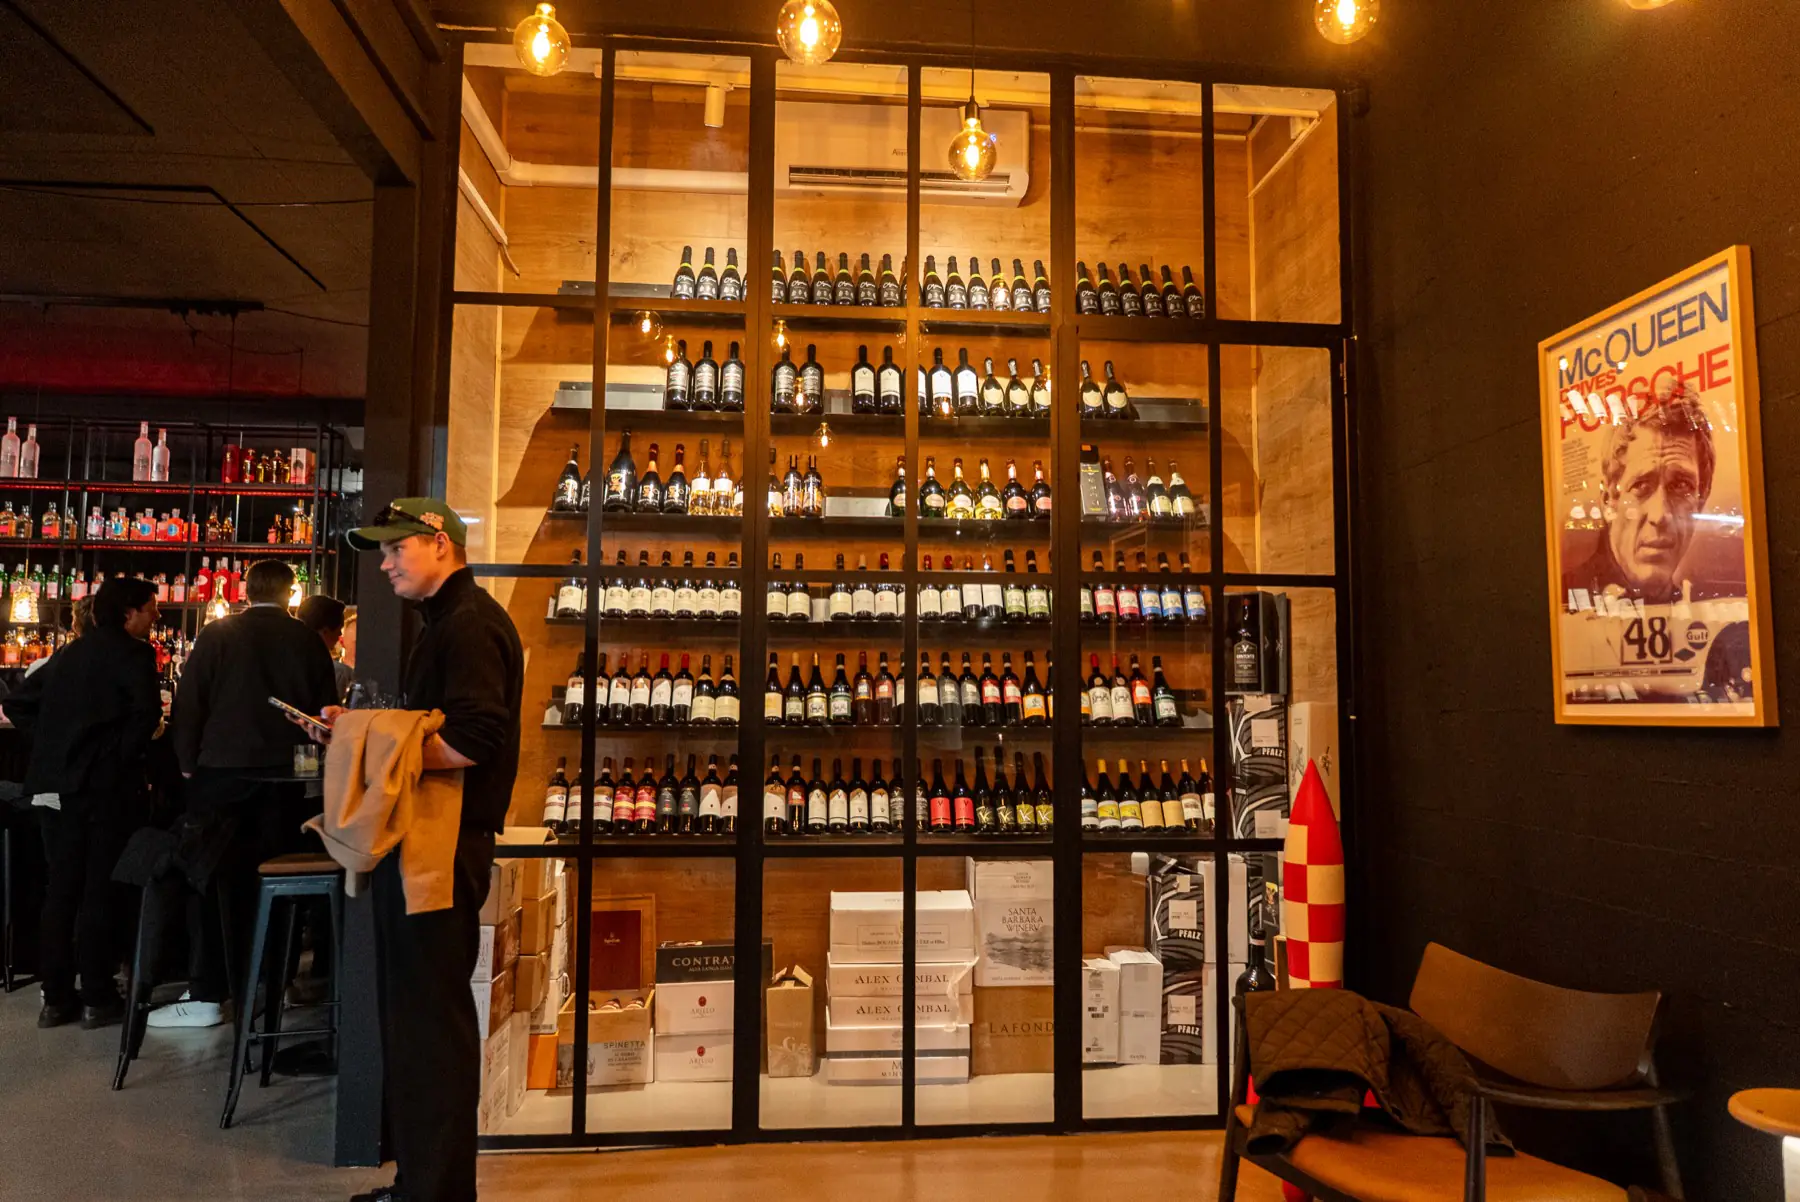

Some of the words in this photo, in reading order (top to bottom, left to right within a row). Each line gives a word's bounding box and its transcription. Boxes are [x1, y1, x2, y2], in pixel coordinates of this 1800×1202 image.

[1623, 616, 1670, 660] 48
[1686, 631, 1709, 641] Gulf
[1262, 747, 1283, 757] PFALZ
[1008, 907, 1037, 916] SANTA
[1001, 915, 1044, 924] BARBARA
[1179, 929, 1201, 940] PFALZ
[855, 974, 891, 984] ALEX
[896, 974, 950, 984] GMBAL
[856, 1005, 891, 1015] ALEX
[897, 1004, 951, 1014] GMBAL
[989, 1021, 1053, 1034] LAFOND
[1177, 1024, 1200, 1036] PFALZ
[603, 1040, 646, 1050] SPINETTA
